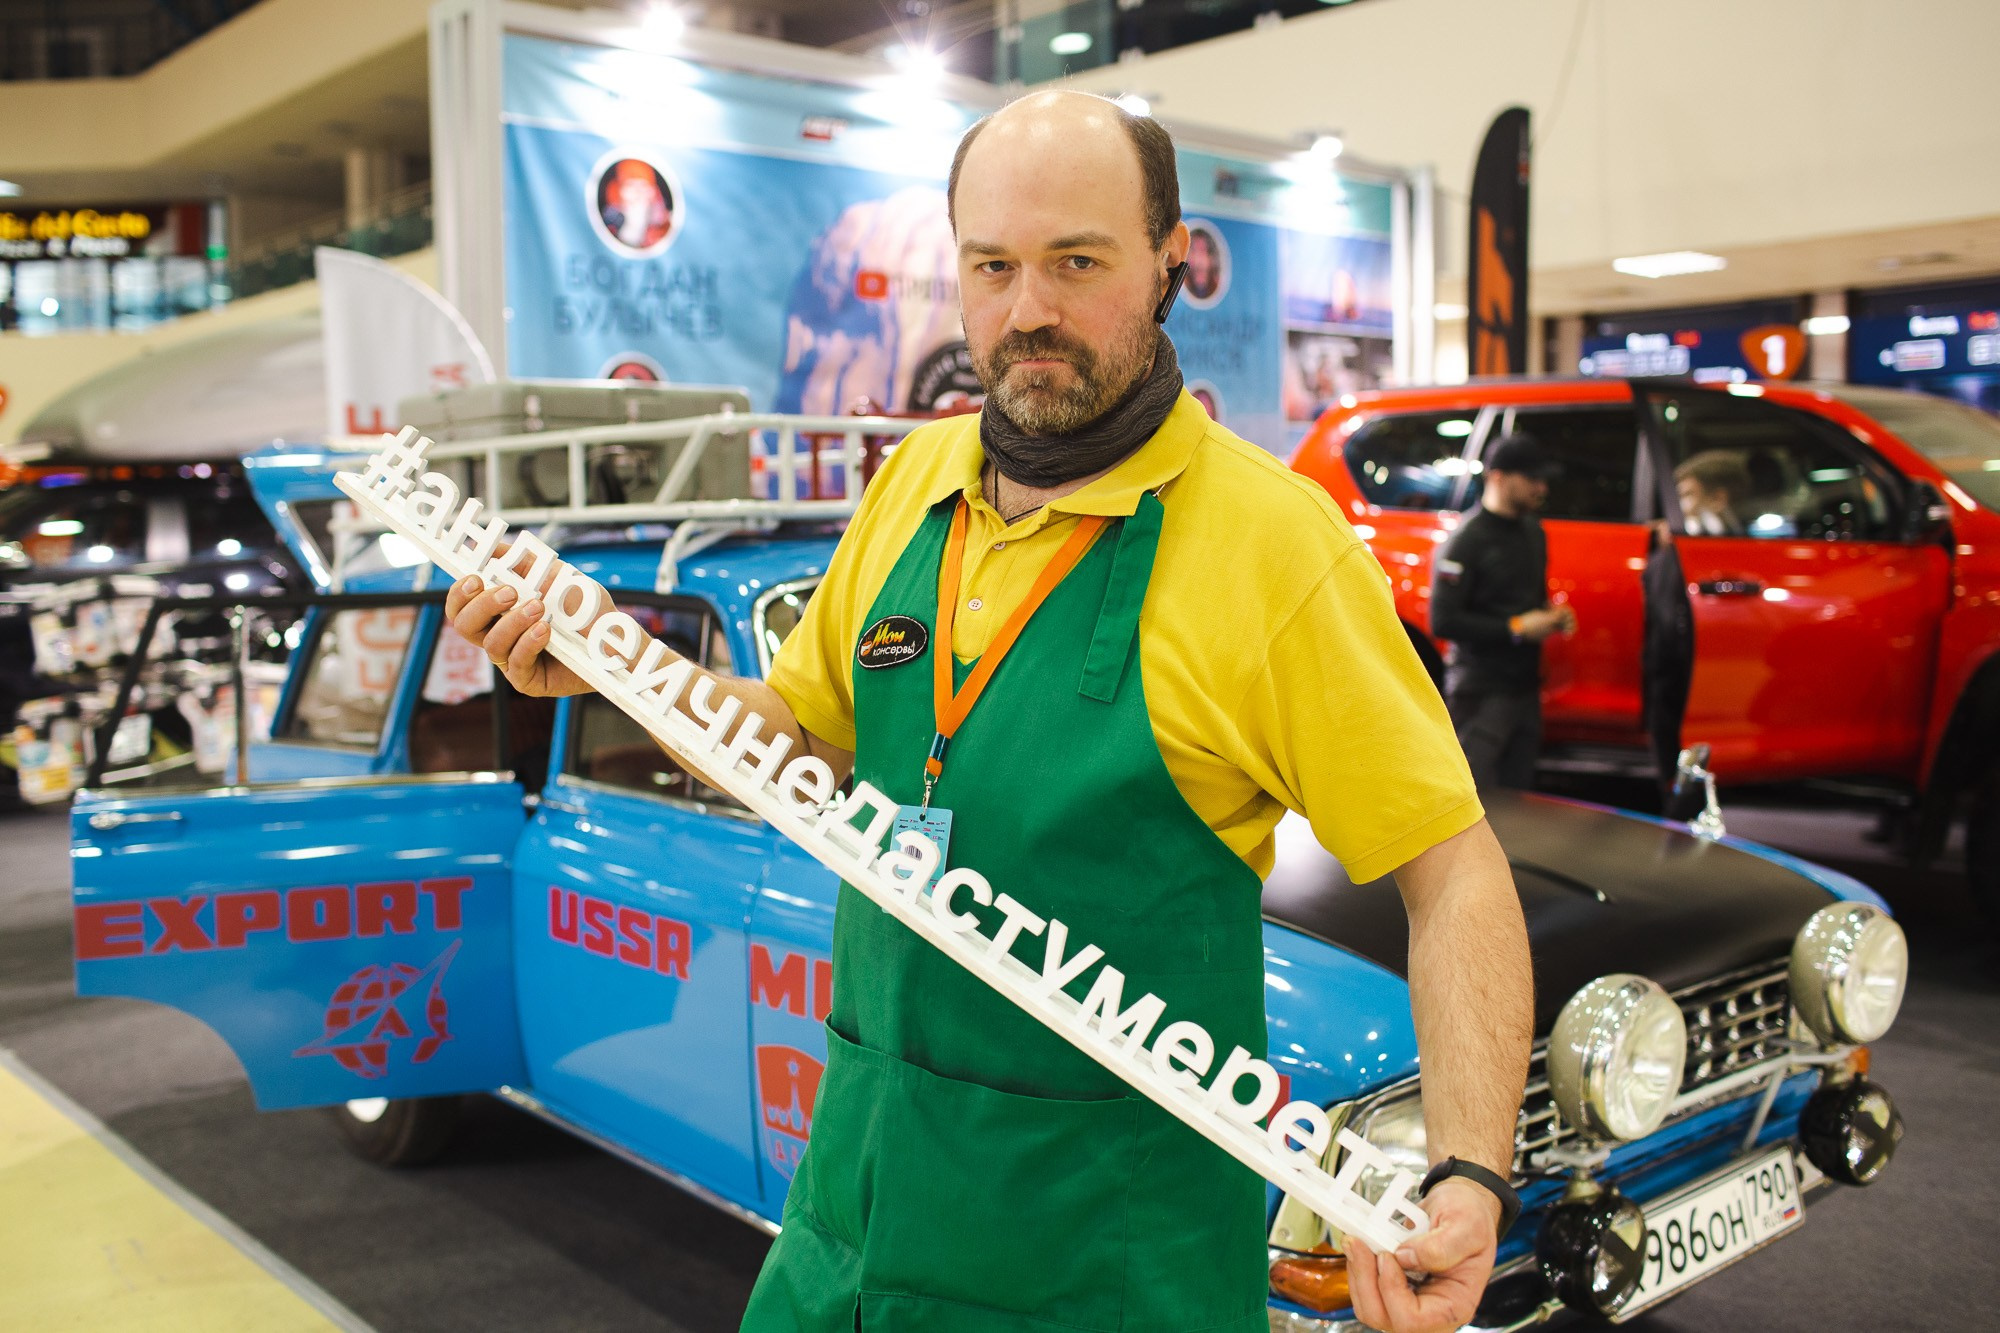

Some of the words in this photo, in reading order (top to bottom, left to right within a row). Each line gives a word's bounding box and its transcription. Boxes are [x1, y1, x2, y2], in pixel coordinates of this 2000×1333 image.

[1761, 334, 1786, 375] 1
[872, 640, 916, 656] консервы
[75, 876, 473, 962] EXPORT
[549, 883, 691, 983] USSR
[1637, 1199, 1748, 1293] 986ОН
[1746, 1162, 1788, 1217] 790
